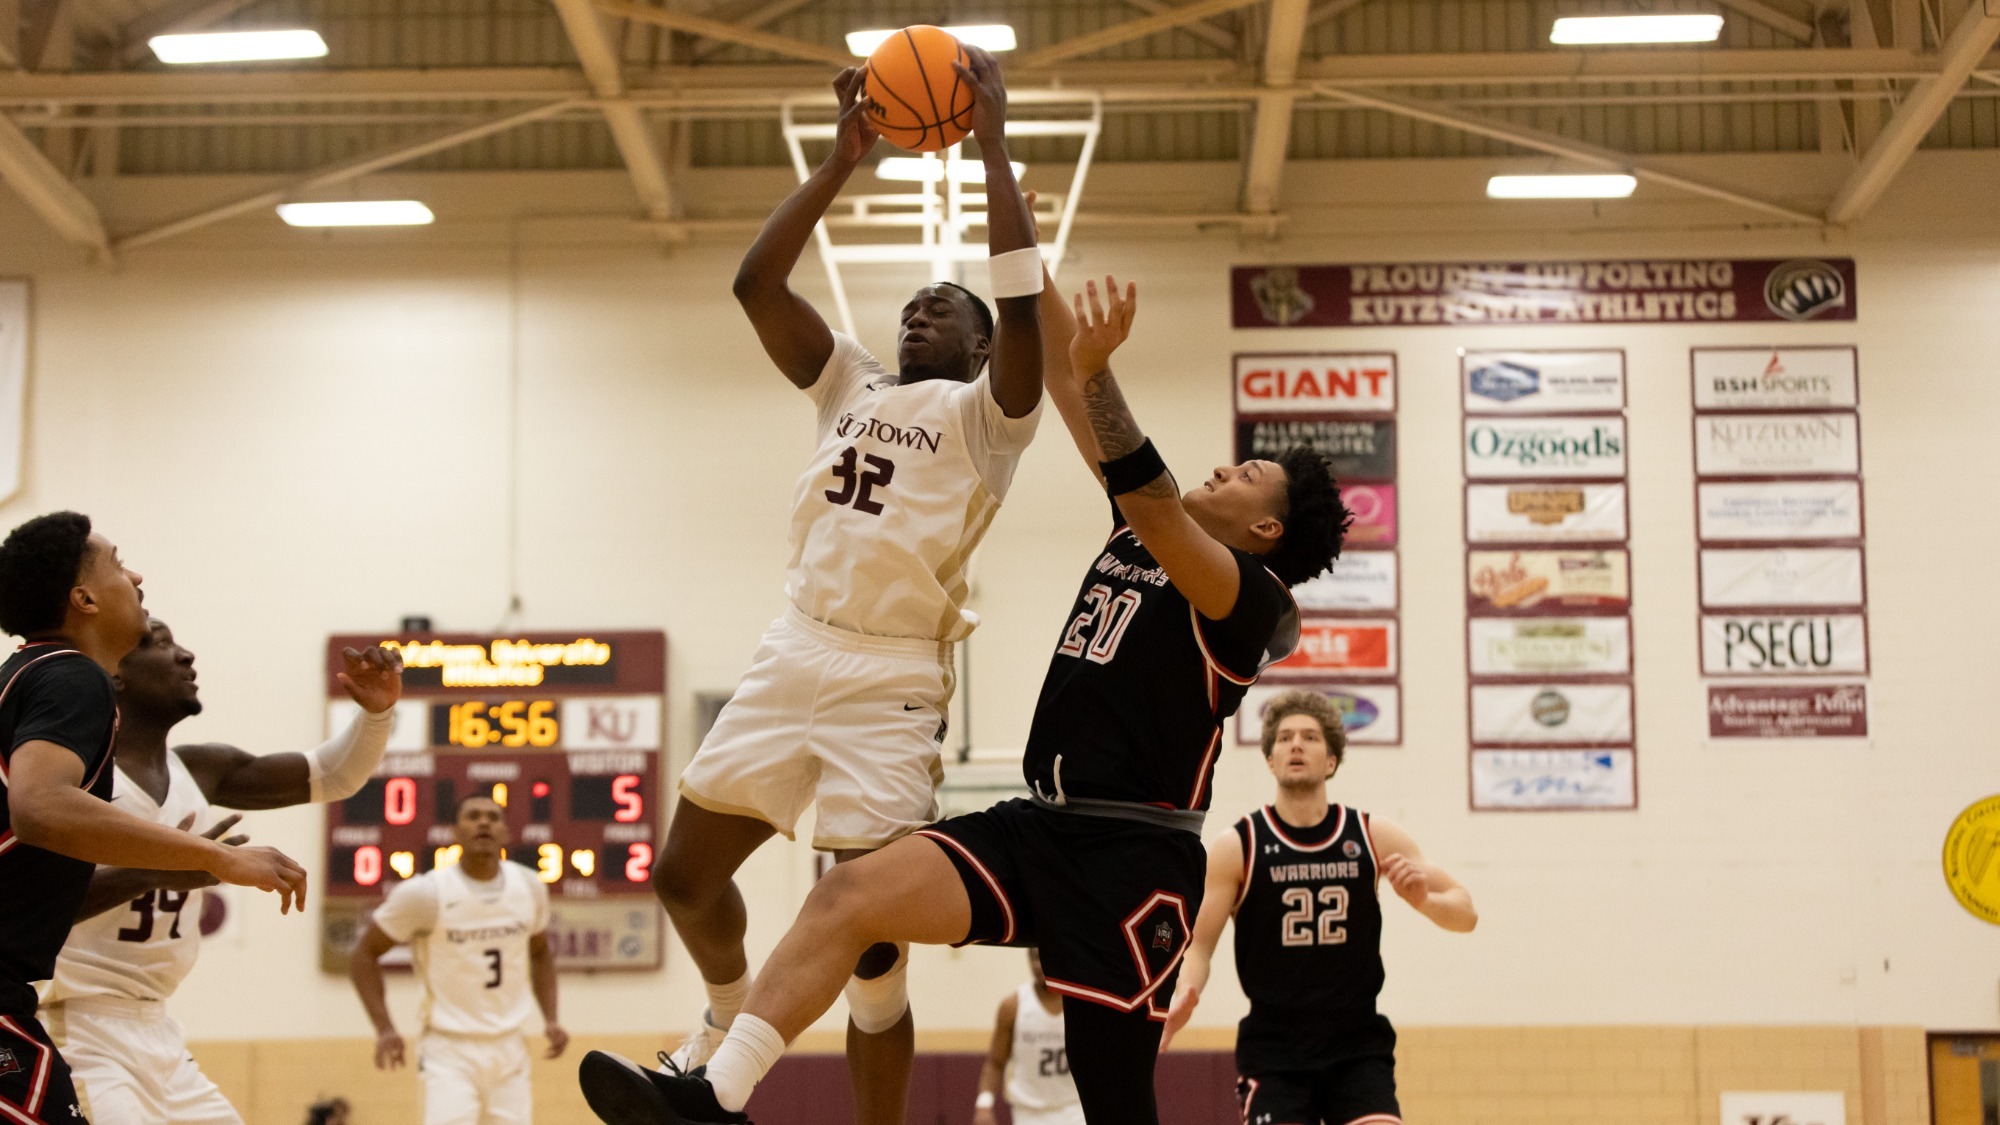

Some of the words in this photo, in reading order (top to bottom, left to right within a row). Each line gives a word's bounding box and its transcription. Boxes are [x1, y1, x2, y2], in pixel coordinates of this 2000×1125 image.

[1242, 369, 1388, 399] GIANT
[1760, 375, 1831, 394] SPORTS
[1470, 425, 1620, 467] Ozgood's
[1710, 416, 1842, 449] KUTZTOWN
[824, 445, 896, 517] 32
[1056, 583, 1142, 666] 20
[1724, 618, 1833, 669] PSECU
[448, 700, 559, 748] 16:56
[588, 704, 639, 743] KU
[384, 777, 417, 826] 0
[611, 774, 644, 823] 5
[353, 845, 383, 886] 0
[624, 842, 653, 883] 2
[1269, 860, 1359, 882] WARRIORS
[1281, 885, 1349, 947] 22
[483, 948, 502, 989] 3
[1038, 1048, 1070, 1077] 20
